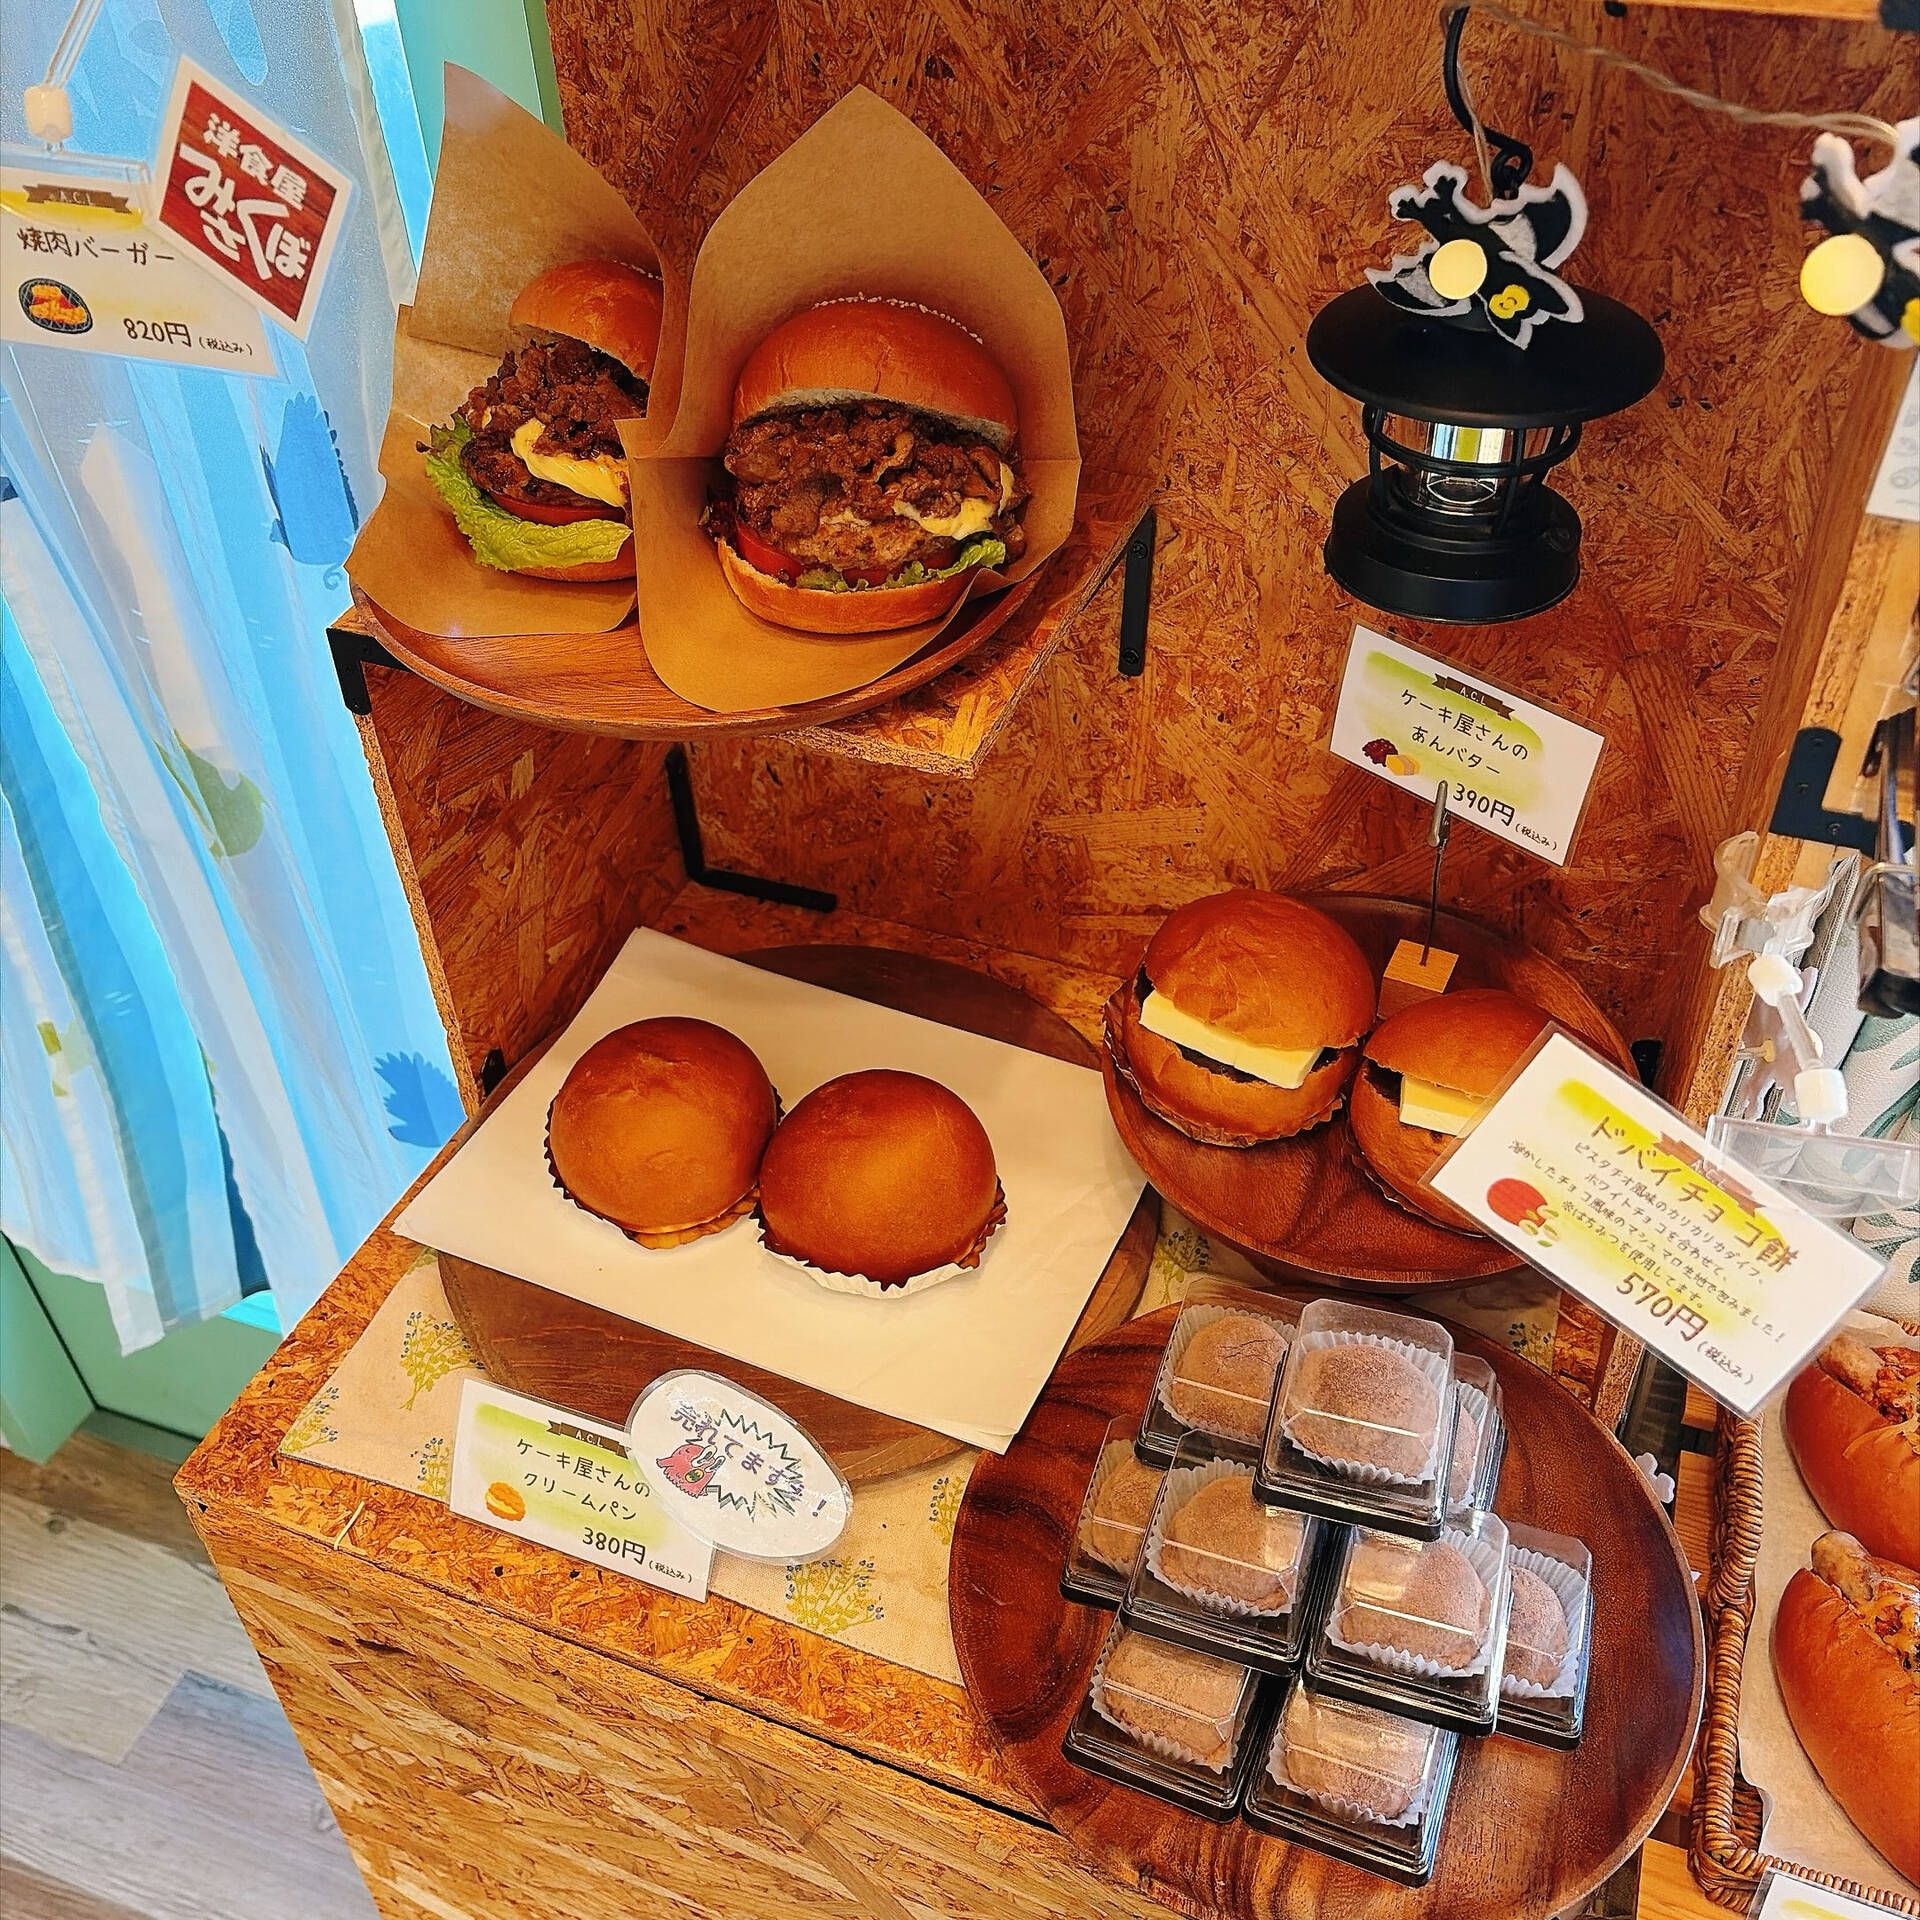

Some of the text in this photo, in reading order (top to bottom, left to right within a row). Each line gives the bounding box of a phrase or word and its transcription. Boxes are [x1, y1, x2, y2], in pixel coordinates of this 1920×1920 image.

[202, 113, 308, 211] 洋食屋
[17, 228, 176, 267] 焼肉バーガー
[123, 318, 254, 356] 820円 （税込み）
[1400, 688, 1529, 761] ケーキ屋さんの
[1411, 725, 1501, 776] あんバター
[1452, 783, 1558, 851] 390円 （税込み）
[1575, 1140, 1764, 1285] ピスタチオ風味のカリカリカダイフ、
[1584, 1171, 1728, 1282] ホワイトチョコを合わせて、
[1591, 1115, 1802, 1274] ドバイチョコ餅
[1561, 1199, 1708, 1310] ※はちみつを使用してます。
[1615, 1271, 1755, 1386] 570円 （税込み）
[515, 1437, 651, 1499] ケーキ屋さんの
[523, 1472, 639, 1522] クリームパン
[581, 1526, 693, 1584] 380円 （税込み）
